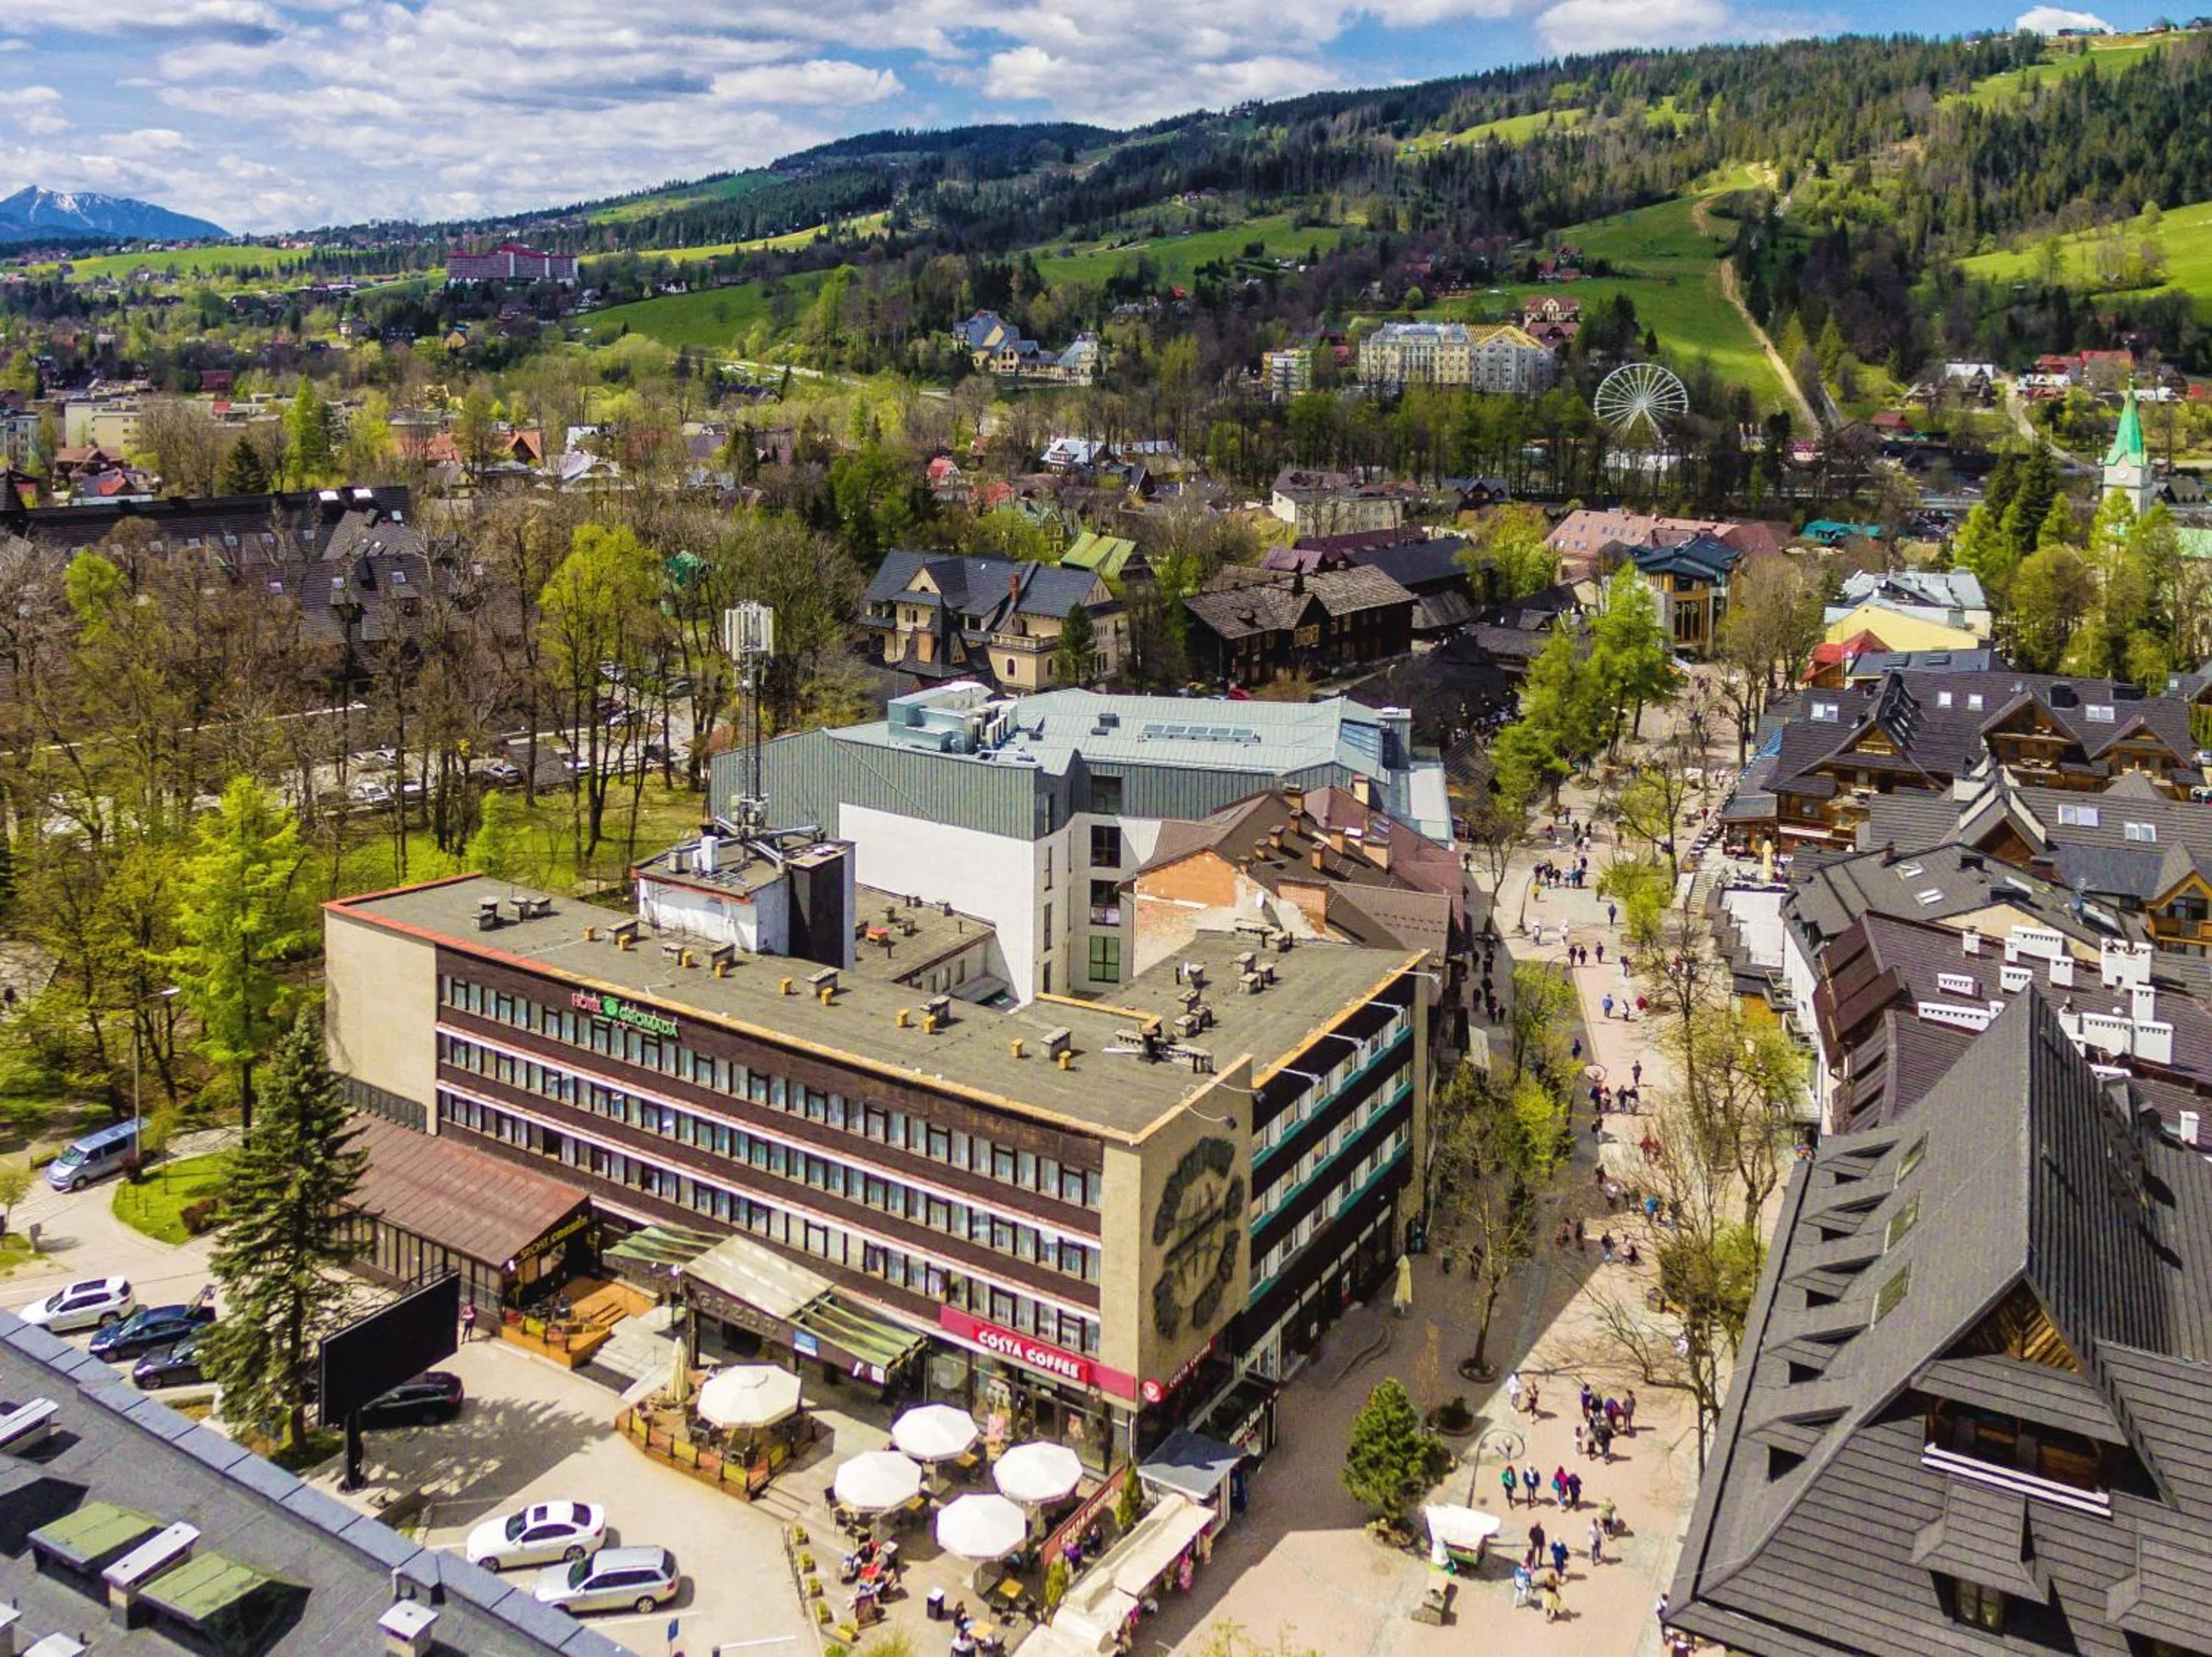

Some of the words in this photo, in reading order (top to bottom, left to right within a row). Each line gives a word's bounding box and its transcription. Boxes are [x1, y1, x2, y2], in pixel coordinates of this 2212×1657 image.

[572, 993, 603, 1014] HOTEL
[619, 1007, 679, 1038] GROMADA
[978, 1330, 1023, 1358] COSTA
[1026, 1348, 1078, 1380] COFFEE
